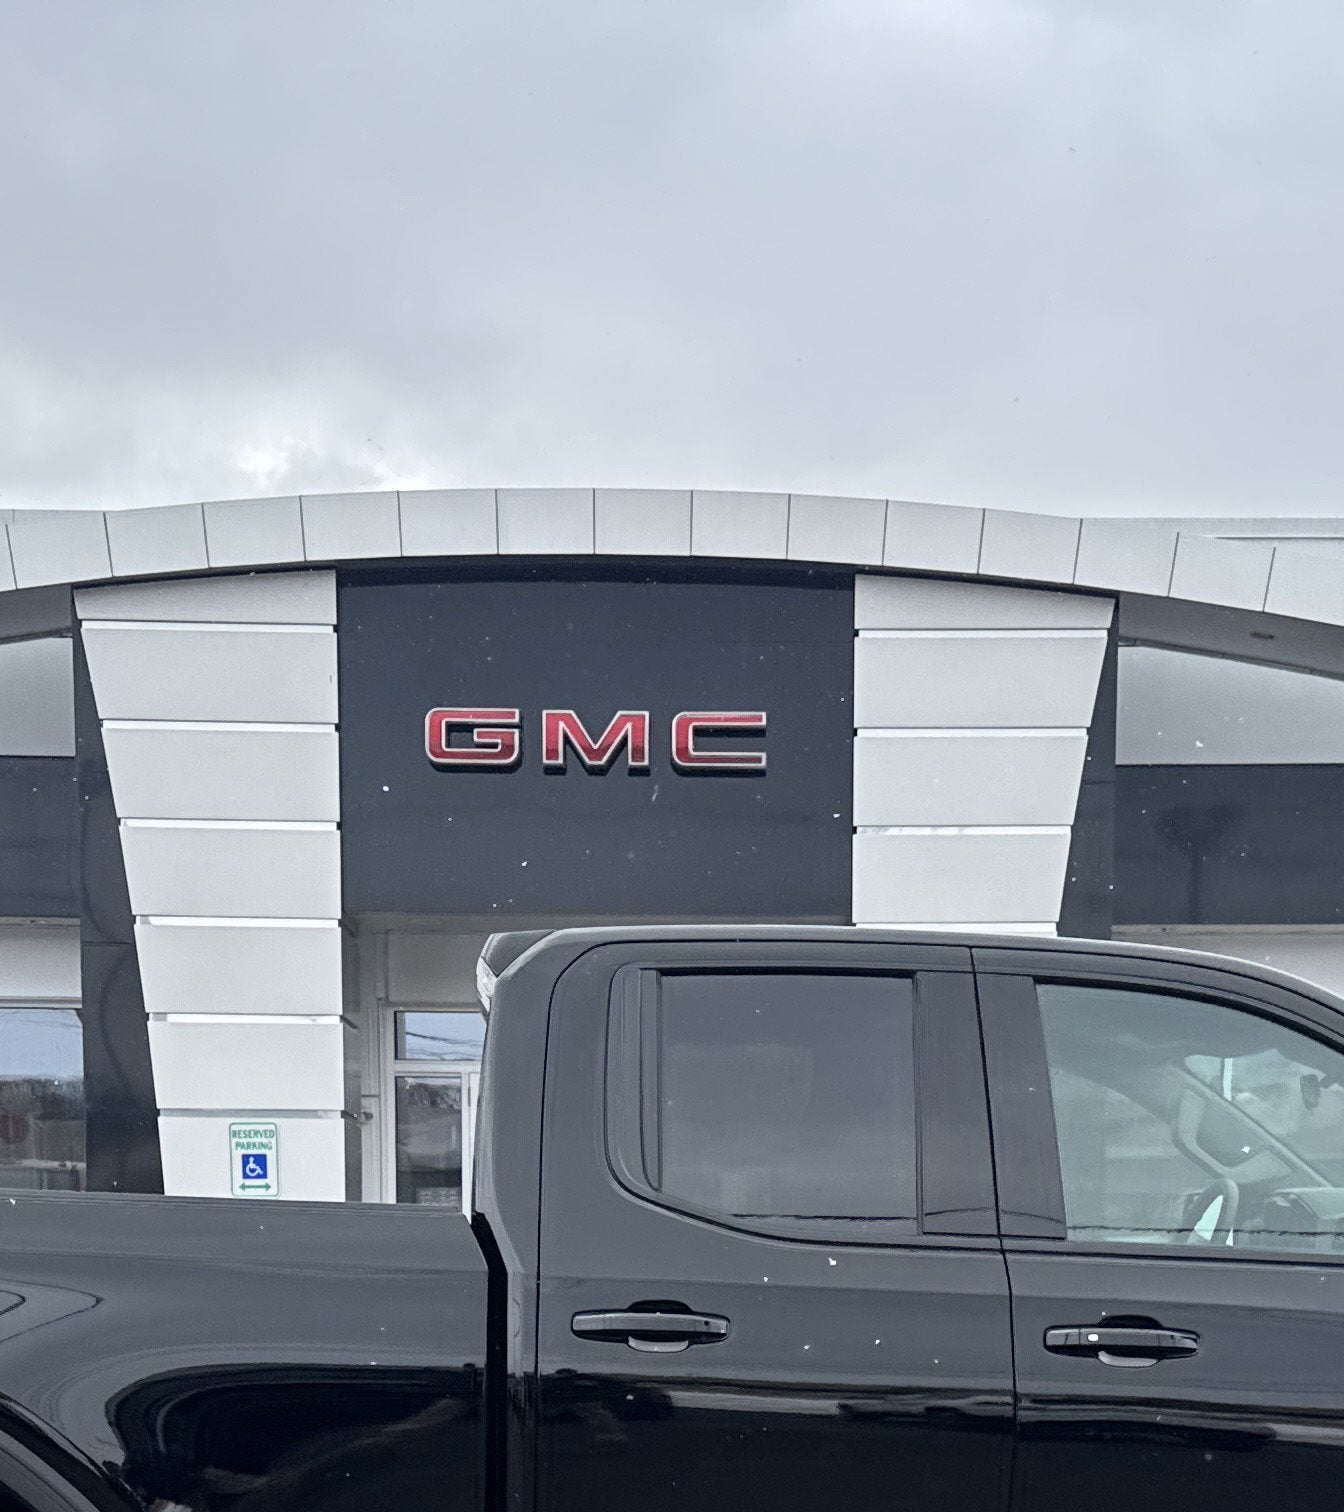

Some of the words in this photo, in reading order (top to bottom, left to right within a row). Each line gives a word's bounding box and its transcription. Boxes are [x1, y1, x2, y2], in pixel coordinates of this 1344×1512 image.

[425, 706, 768, 768] GMC
[231, 1129, 275, 1139] RESERVED
[235, 1141, 273, 1150] PARKING
